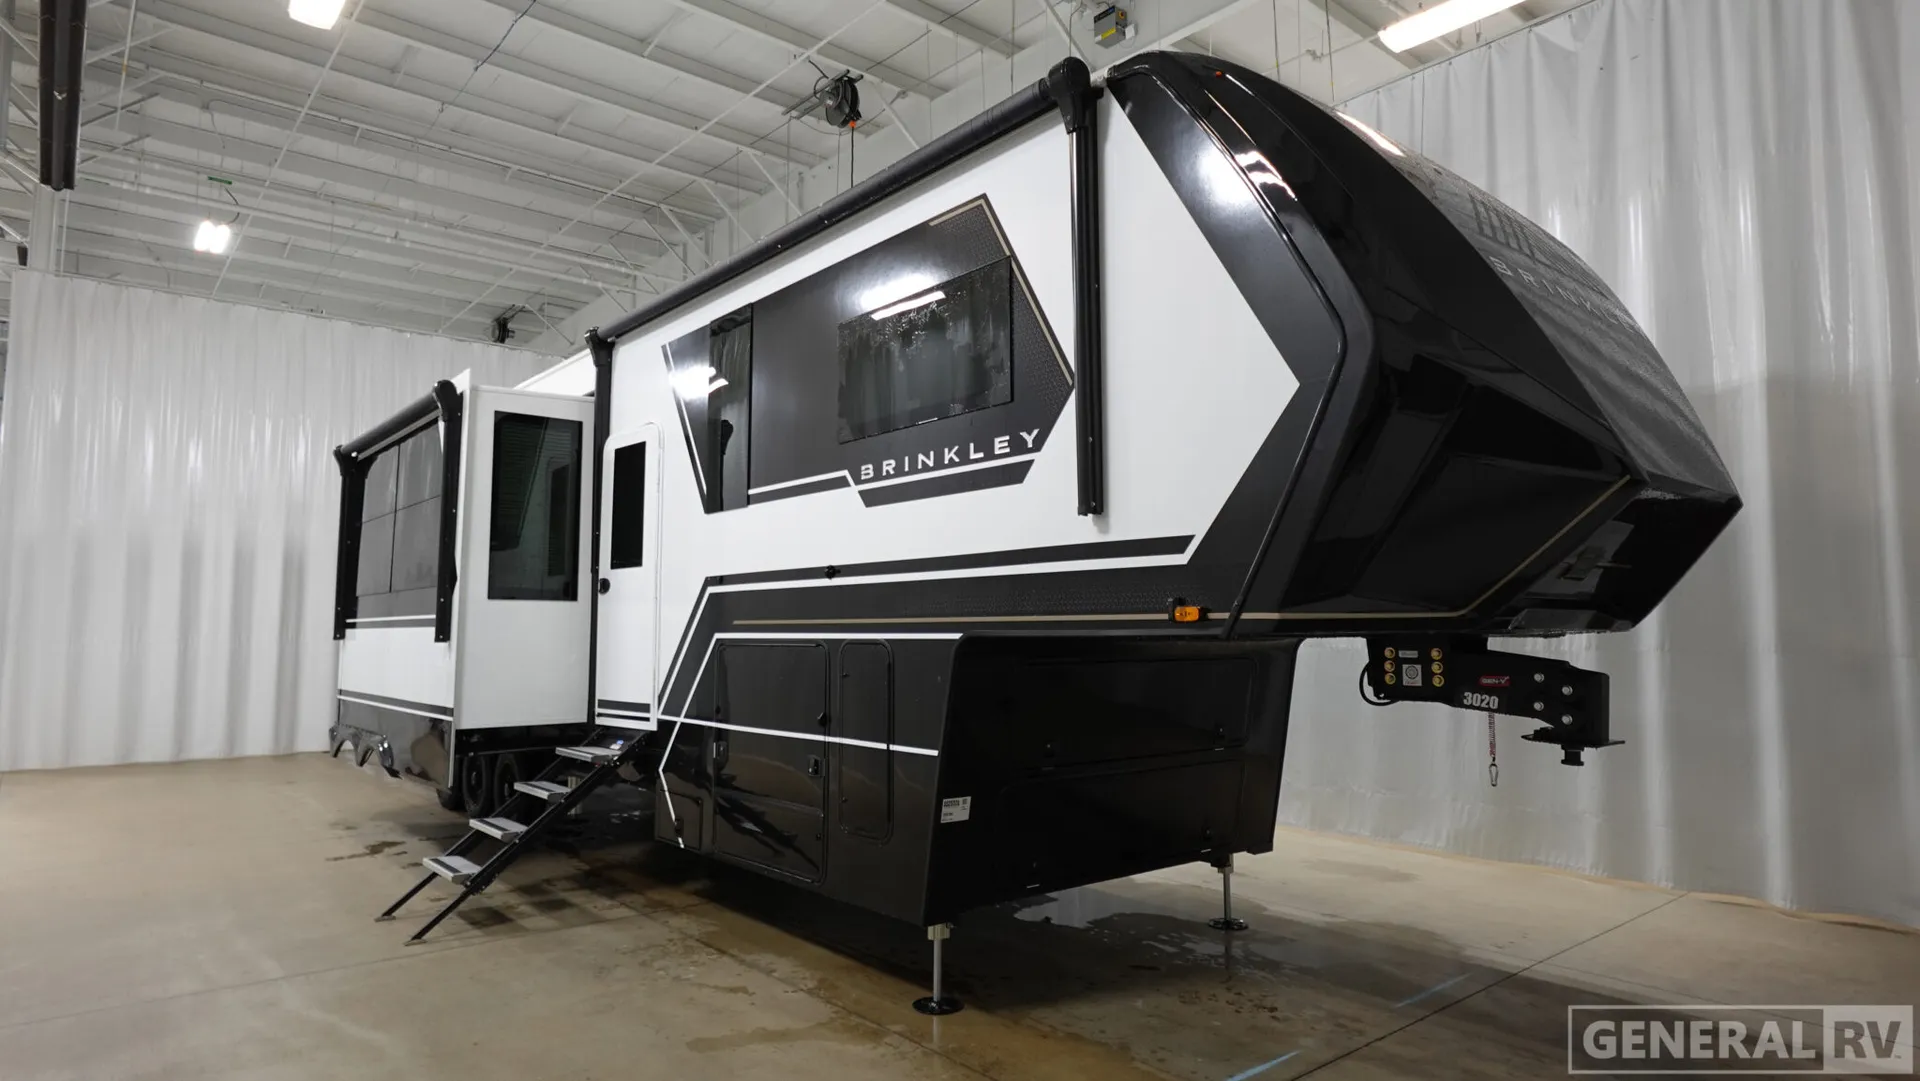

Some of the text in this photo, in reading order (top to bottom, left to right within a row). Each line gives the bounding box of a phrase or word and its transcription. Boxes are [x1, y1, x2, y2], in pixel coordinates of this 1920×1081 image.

[1488, 255, 1640, 335] BRINKLE
[861, 428, 1040, 480] BRINKLEY
[1463, 691, 1499, 710] 3020
